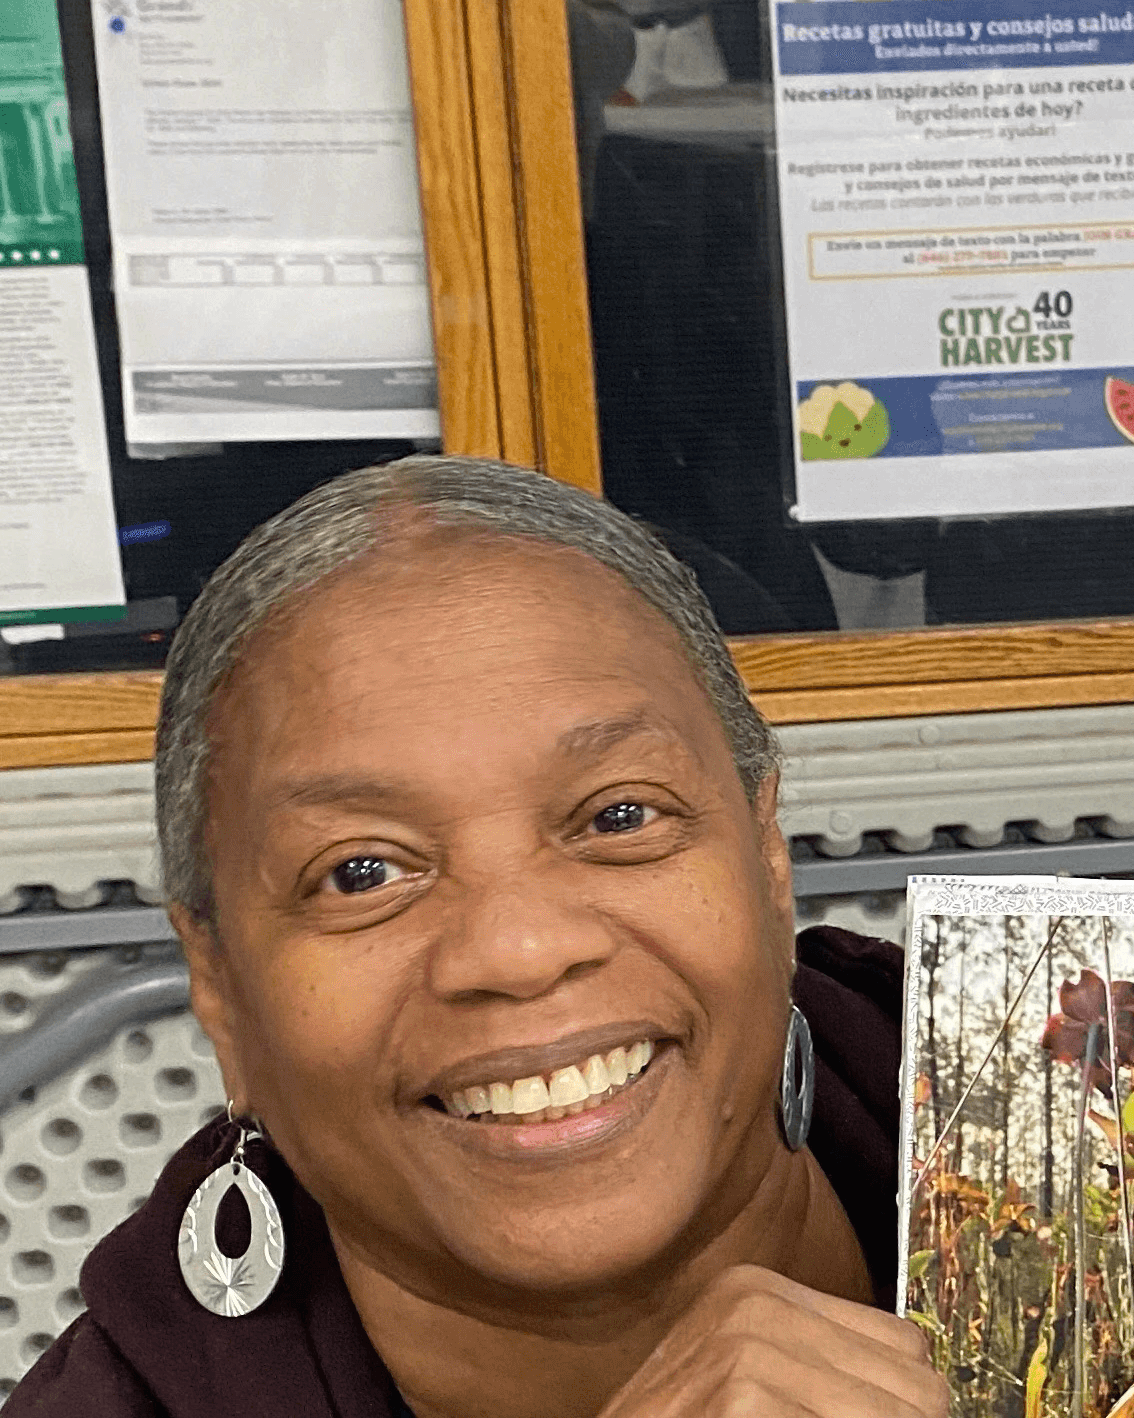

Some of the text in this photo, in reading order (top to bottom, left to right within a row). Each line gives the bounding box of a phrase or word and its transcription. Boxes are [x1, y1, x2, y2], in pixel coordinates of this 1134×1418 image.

[782, 23, 865, 43] Recetas
[868, 18, 965, 44] gratuitas
[968, 21, 983, 41] y
[986, 13, 1075, 38] consejos
[783, 86, 873, 102] Necesitas
[876, 81, 978, 104] inspiración
[983, 82, 1024, 99] para
[1029, 80, 1064, 95] una
[1068, 78, 1125, 94] receta
[896, 99, 1084, 125] ingredientes de hoy?
[868, 162, 902, 176] para
[1033, 290, 1073, 318] 40
[938, 306, 1004, 337] CITY
[1035, 320, 1071, 330] YEARS
[940, 333, 1074, 367] HARVEST
